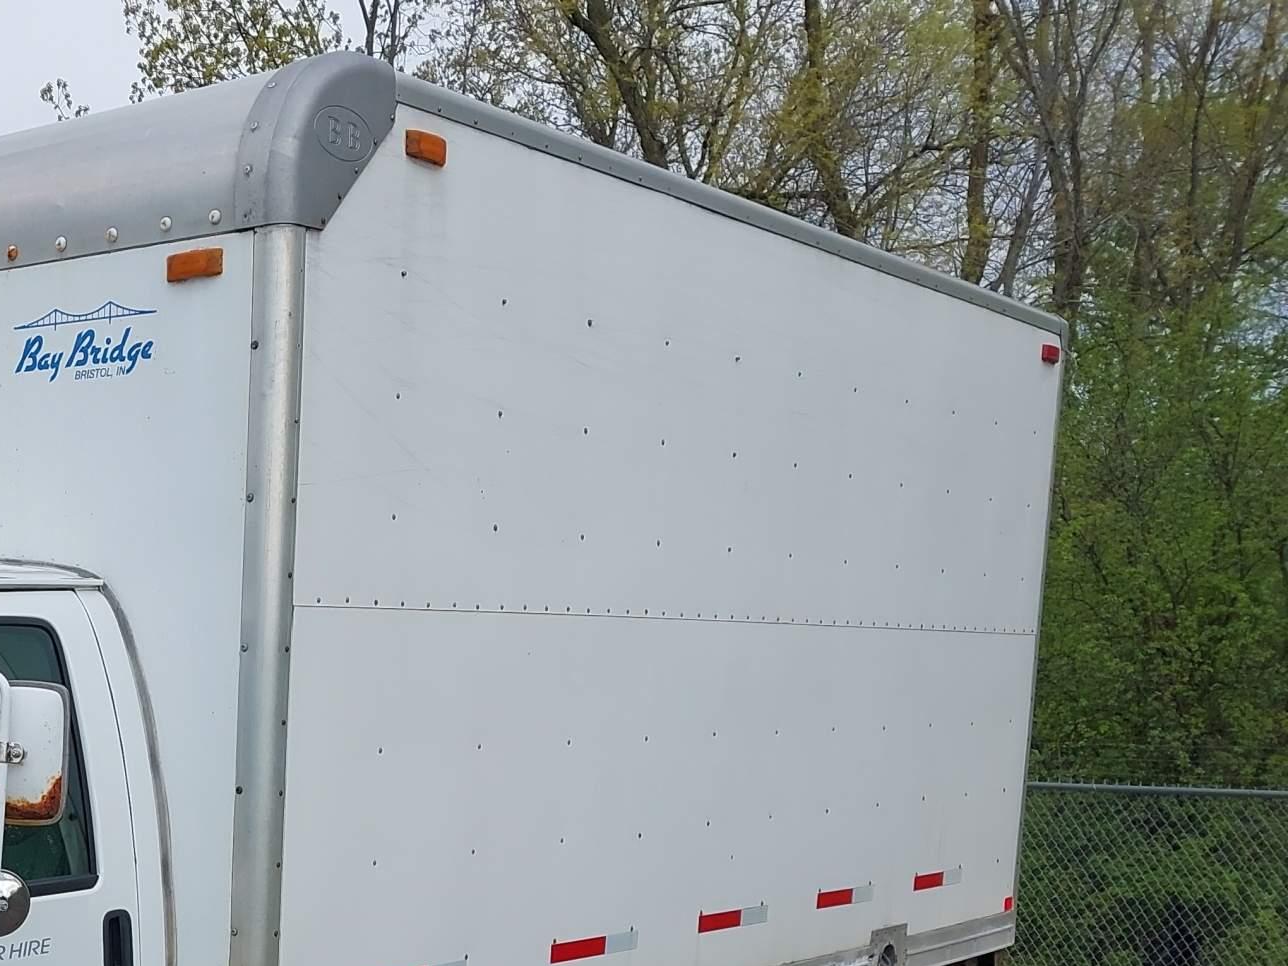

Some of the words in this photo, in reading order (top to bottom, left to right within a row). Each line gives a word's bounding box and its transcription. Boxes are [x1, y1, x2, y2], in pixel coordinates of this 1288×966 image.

[15, 334, 64, 382] Bay
[65, 326, 154, 375] Bridge
[74, 367, 113, 380] BRISTOL,
[116, 366, 127, 376] IN
[9, 938, 51, 959] HIRE
